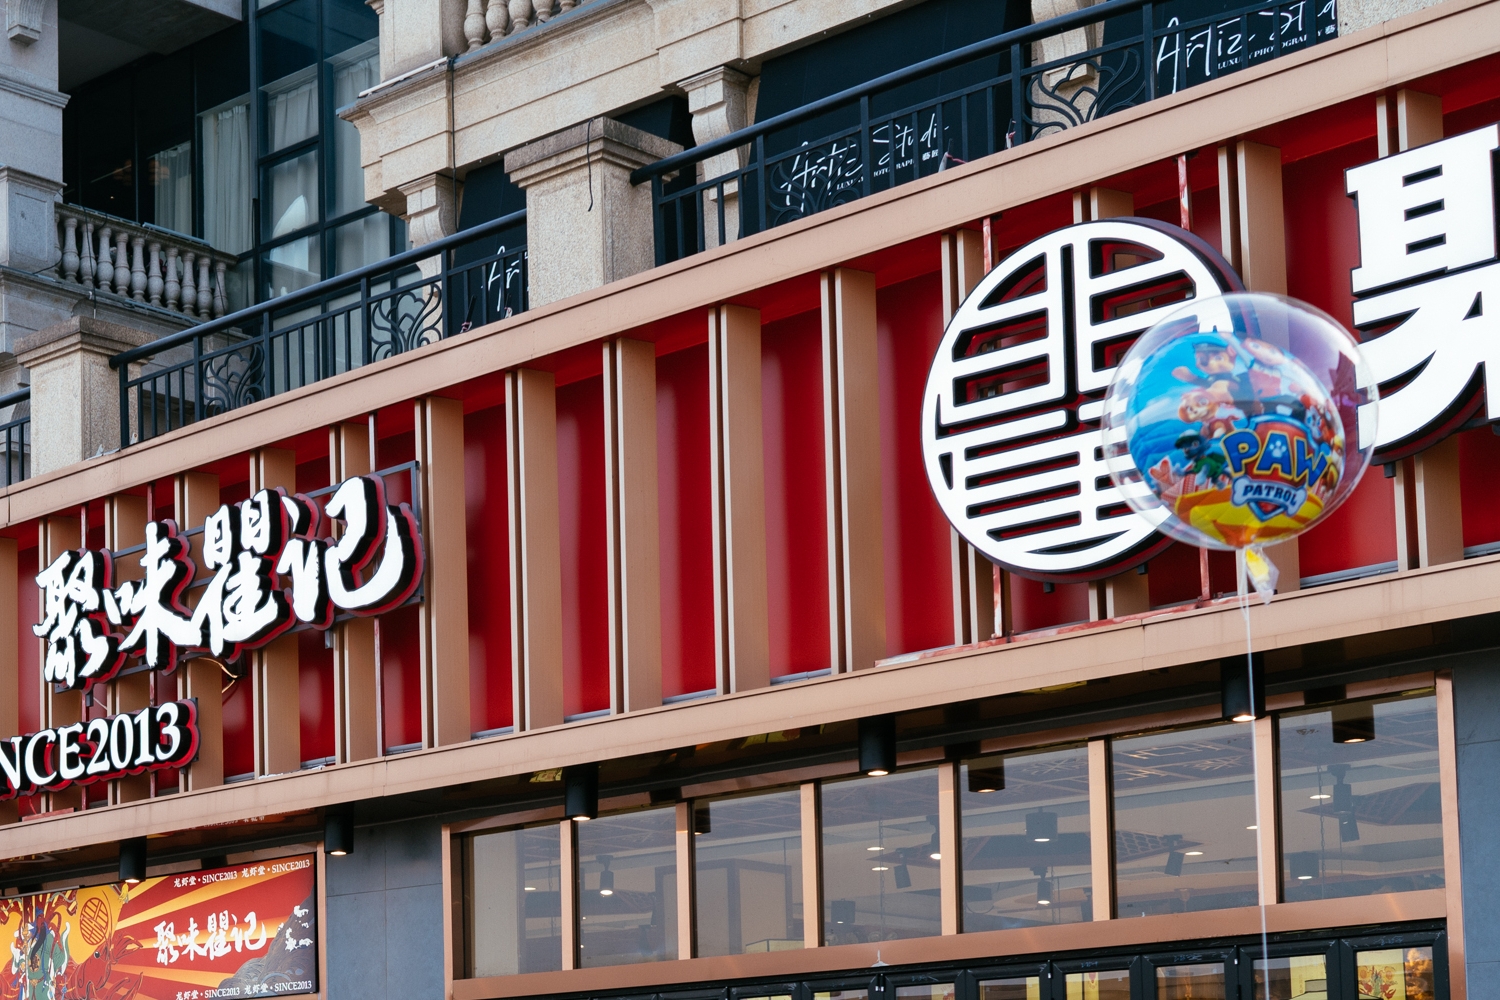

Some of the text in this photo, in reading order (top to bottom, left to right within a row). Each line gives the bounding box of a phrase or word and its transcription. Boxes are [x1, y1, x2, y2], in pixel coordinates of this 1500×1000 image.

[872, 112, 950, 166] Studi
[1221, 428, 1329, 489] PAW
[1242, 484, 1298, 506] PATROL
[33, 474, 405, 689] 聚味瞿记
[152, 909, 268, 966] 聚味瞿记
